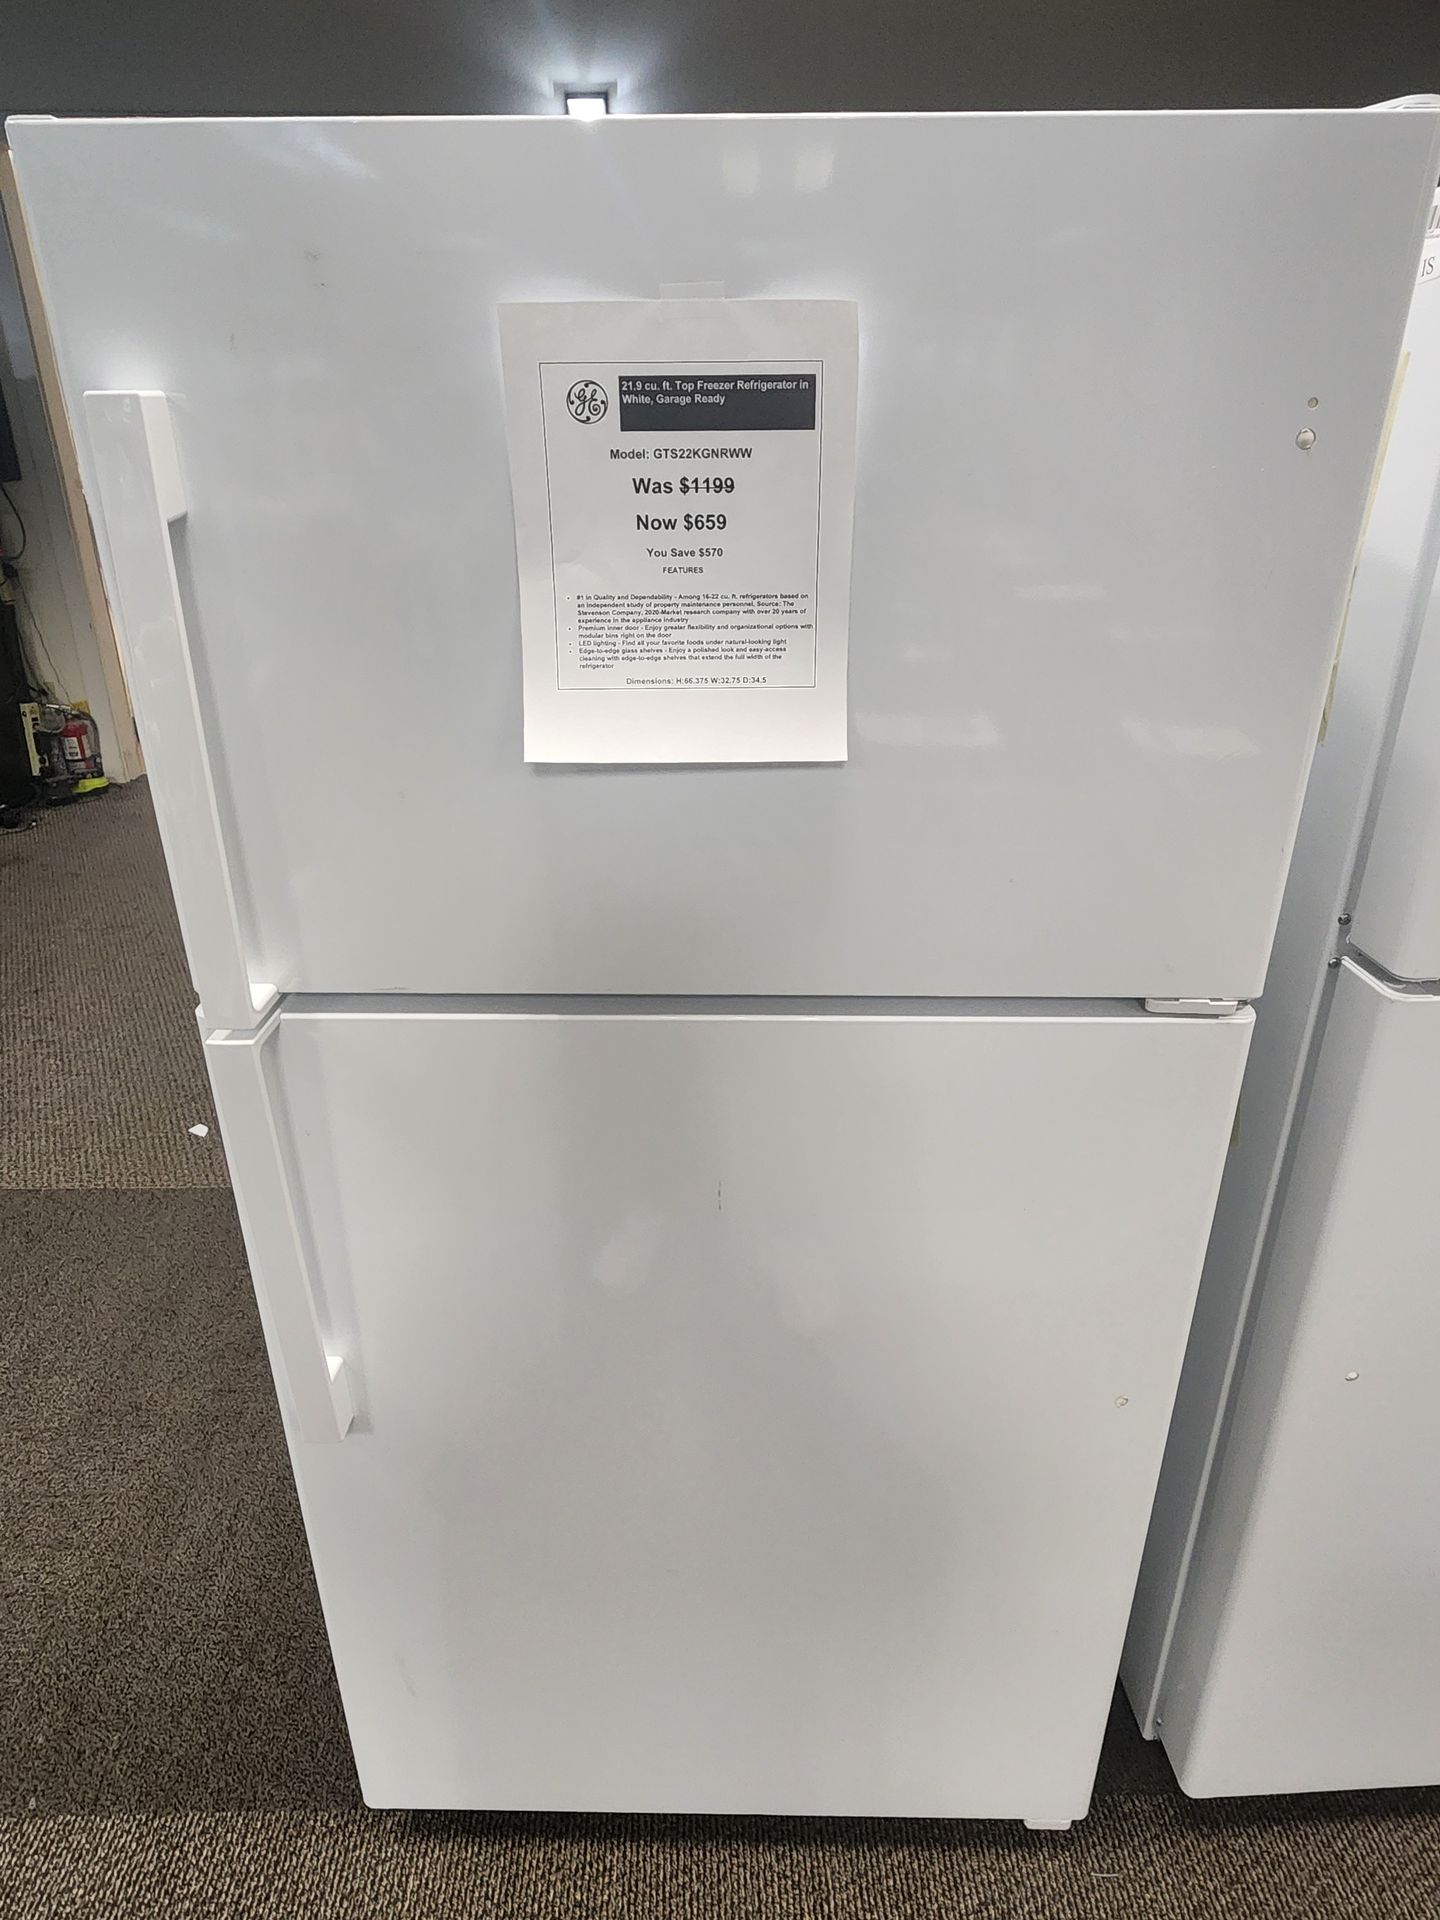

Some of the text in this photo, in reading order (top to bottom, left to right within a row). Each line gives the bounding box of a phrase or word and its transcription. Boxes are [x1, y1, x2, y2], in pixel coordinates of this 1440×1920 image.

[621, 381, 642, 391] 21.9
[662, 381, 672, 390] ft.
[675, 381, 694, 392] Top
[697, 380, 734, 390] Freezer
[736, 380, 796, 392] Refrigerator
[800, 380, 809, 389] in
[622, 394, 726, 406] White, Garage Ready
[610, 448, 752, 460] Model: GTS22KGNRWW
[632, 476, 735, 495] Was $1199
[636, 513, 727, 531] Now $659
[647, 547, 723, 558] You Save $570
